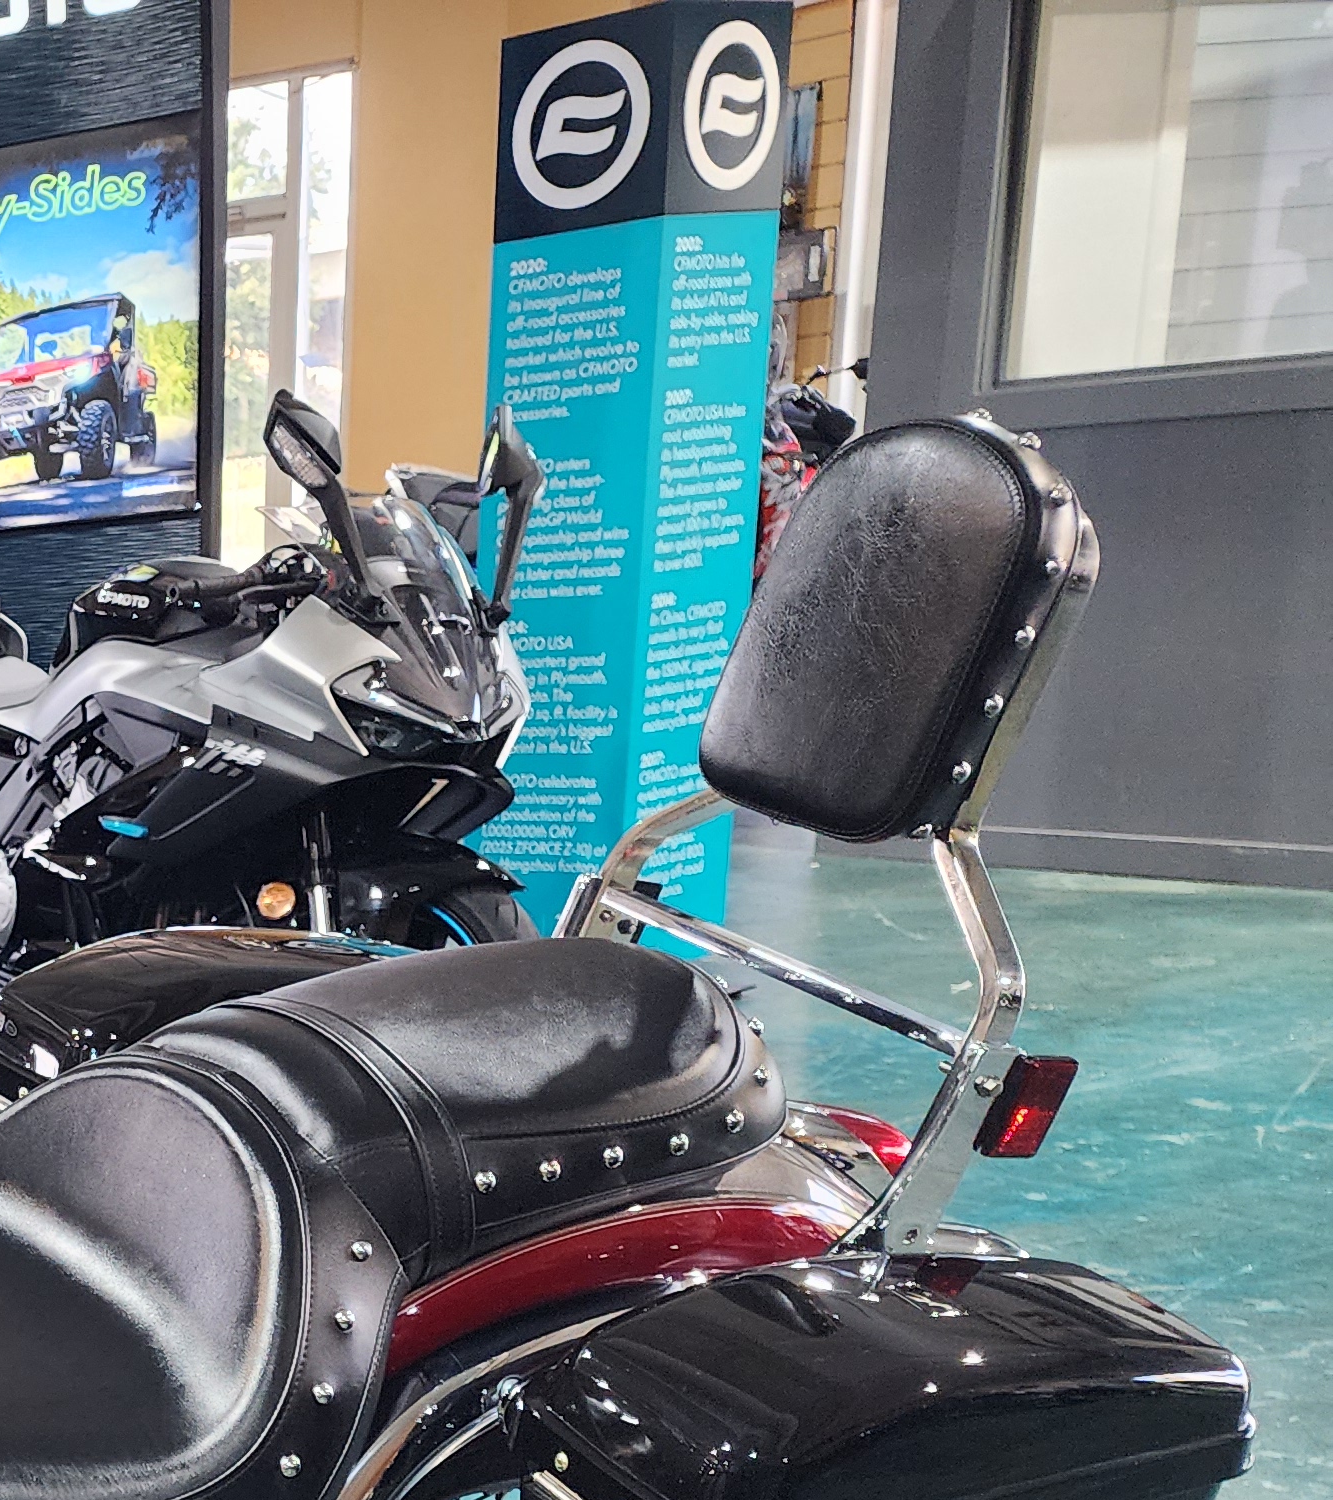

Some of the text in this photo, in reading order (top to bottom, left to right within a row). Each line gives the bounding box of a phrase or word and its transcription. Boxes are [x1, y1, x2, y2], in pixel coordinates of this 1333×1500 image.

[510, 258, 548, 277] 2020:
[509, 268, 621, 294] CFMOTO develops
[606, 282, 621, 299] of
[507, 304, 625, 332] off-road accessories
[554, 328, 572, 343] for
[574, 326, 593, 341] the
[595, 321, 619, 338] U.S.
[626, 340, 639, 353] to
[504, 372, 520, 387] be
[562, 368, 577, 380] as
[579, 357, 638, 377] CFMOTO
[503, 377, 621, 404] CRAFTED parts and
[513, 405, 570, 422] ccessories.
[581, 490, 596, 506] of
[527, 512, 566, 528] otoGP
[547, 635, 573, 650] USA
